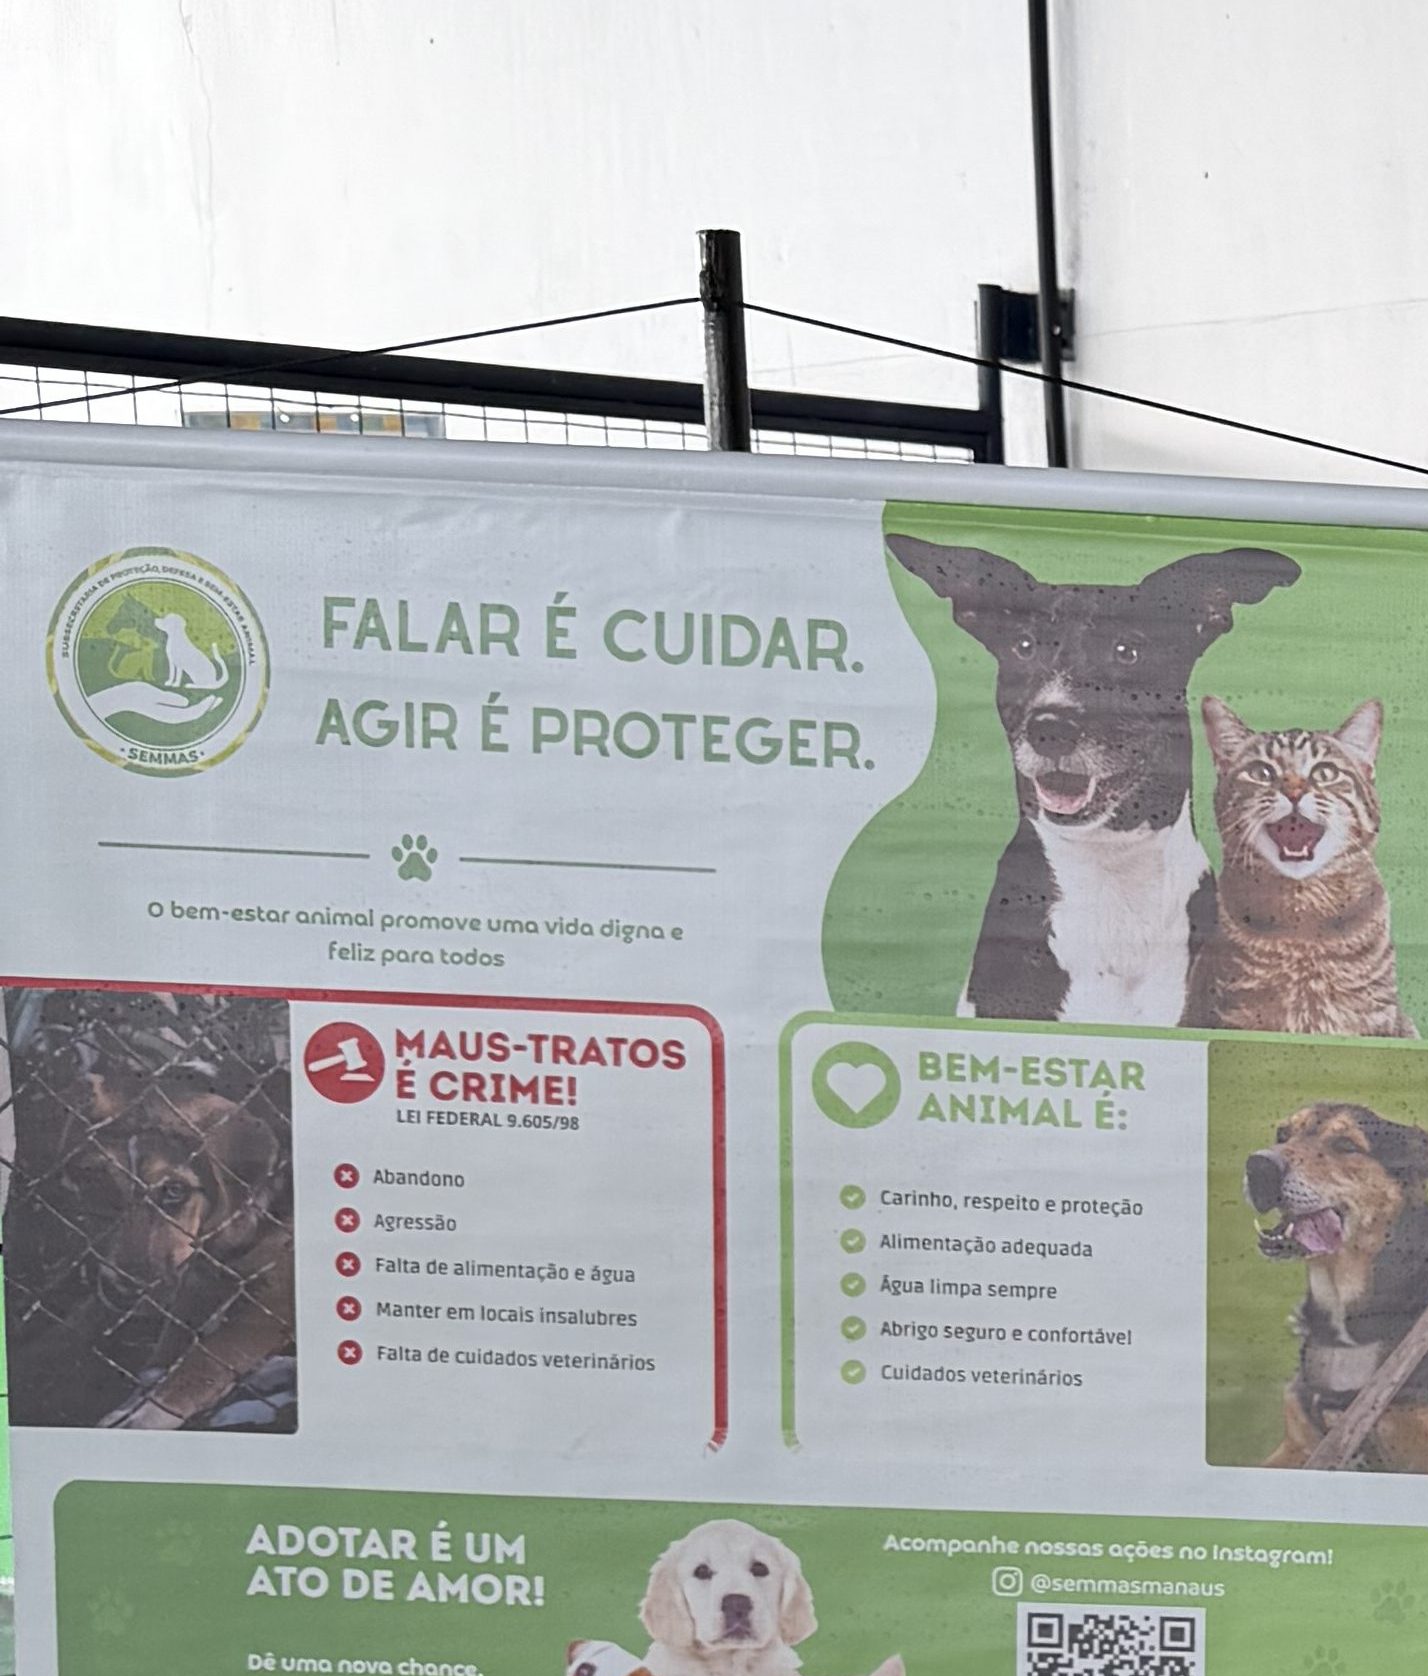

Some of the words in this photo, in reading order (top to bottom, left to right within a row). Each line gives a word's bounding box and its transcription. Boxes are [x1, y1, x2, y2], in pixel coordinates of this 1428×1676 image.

[323, 597, 519, 657] FALAR
[546, 594, 576, 660] É
[604, 609, 864, 673] CUIDAR.
[316, 698, 455, 749] AGIR
[481, 692, 509, 753] É
[532, 707, 876, 770] PROTEGER.
[128, 748, 199, 765] SEMMAS
[147, 903, 164, 919] O
[171, 902, 290, 927] bem-estar
[296, 906, 373, 929] animal
[381, 914, 481, 934] promove
[487, 917, 539, 935] uma
[545, 917, 595, 937] vida
[600, 919, 664, 944] digna
[670, 925, 683, 940] e
[328, 940, 375, 963] feliz
[380, 949, 434, 969] para
[439, 946, 505, 968] todos
[396, 1028, 686, 1070] MAUS-TRATOS
[396, 1060, 416, 1099] É
[430, 1071, 577, 1106] CRIME!
[919, 1052, 1146, 1091] BEM-ESTAR
[397, 1110, 421, 1124] LEI
[427, 1111, 502, 1128] FEDERAL
[508, 1114, 579, 1130] 9.605/98
[917, 1093, 1081, 1128] ANIMAL
[1096, 1091, 1127, 1130] É:
[373, 1169, 464, 1187] Abandono
[881, 1190, 958, 1210] Carinho,
[964, 1194, 1039, 1213] respeito
[1046, 1199, 1056, 1211] e
[1061, 1198, 1143, 1218] proteção
[374, 1213, 456, 1232] Agressão
[880, 1234, 996, 1254] Alimentação
[1001, 1239, 1093, 1259] adequada
[376, 1257, 419, 1274] Falta
[426, 1259, 448, 1275] de
[453, 1260, 568, 1282] alimentação
[575, 1268, 585, 1281] e
[591, 1266, 635, 1285] água
[880, 1275, 924, 1295] Água
[930, 1279, 982, 1298] limpa
[988, 1284, 1057, 1301] sempre
[377, 1301, 441, 1319] Manter
[447, 1307, 475, 1321] em
[481, 1305, 534, 1324] locais
[540, 1307, 637, 1327] insalubres
[881, 1321, 938, 1340] Abrigo
[944, 1325, 1006, 1342] seguro
[1012, 1328, 1022, 1341] e
[1028, 1327, 1131, 1345] confortável
[377, 1346, 421, 1362] Falta
[428, 1348, 449, 1363] de
[455, 1348, 537, 1368] cuidados
[542, 1352, 655, 1371] veterinários
[881, 1364, 966, 1382] Cuidados
[971, 1368, 1082, 1386] veterinários
[246, 1524, 418, 1560] ADOTAR
[431, 1520, 452, 1562] É
[465, 1532, 525, 1564] UM
[883, 1534, 1019, 1557] Acompanhe
[1025, 1540, 1102, 1557] nossas
[1109, 1542, 1173, 1563] ações
[1180, 1545, 1206, 1560] no
[1213, 1544, 1333, 1567] Instagram!
[246, 1566, 328, 1597] ATO
[343, 1569, 394, 1600] DE
[407, 1571, 544, 1606] AMOR!
[1031, 1573, 1225, 1597] @semmasmanaus
[248, 1652, 276, 1671] Dê
[281, 1658, 332, 1673] uma
[338, 1660, 392, 1675] nova
